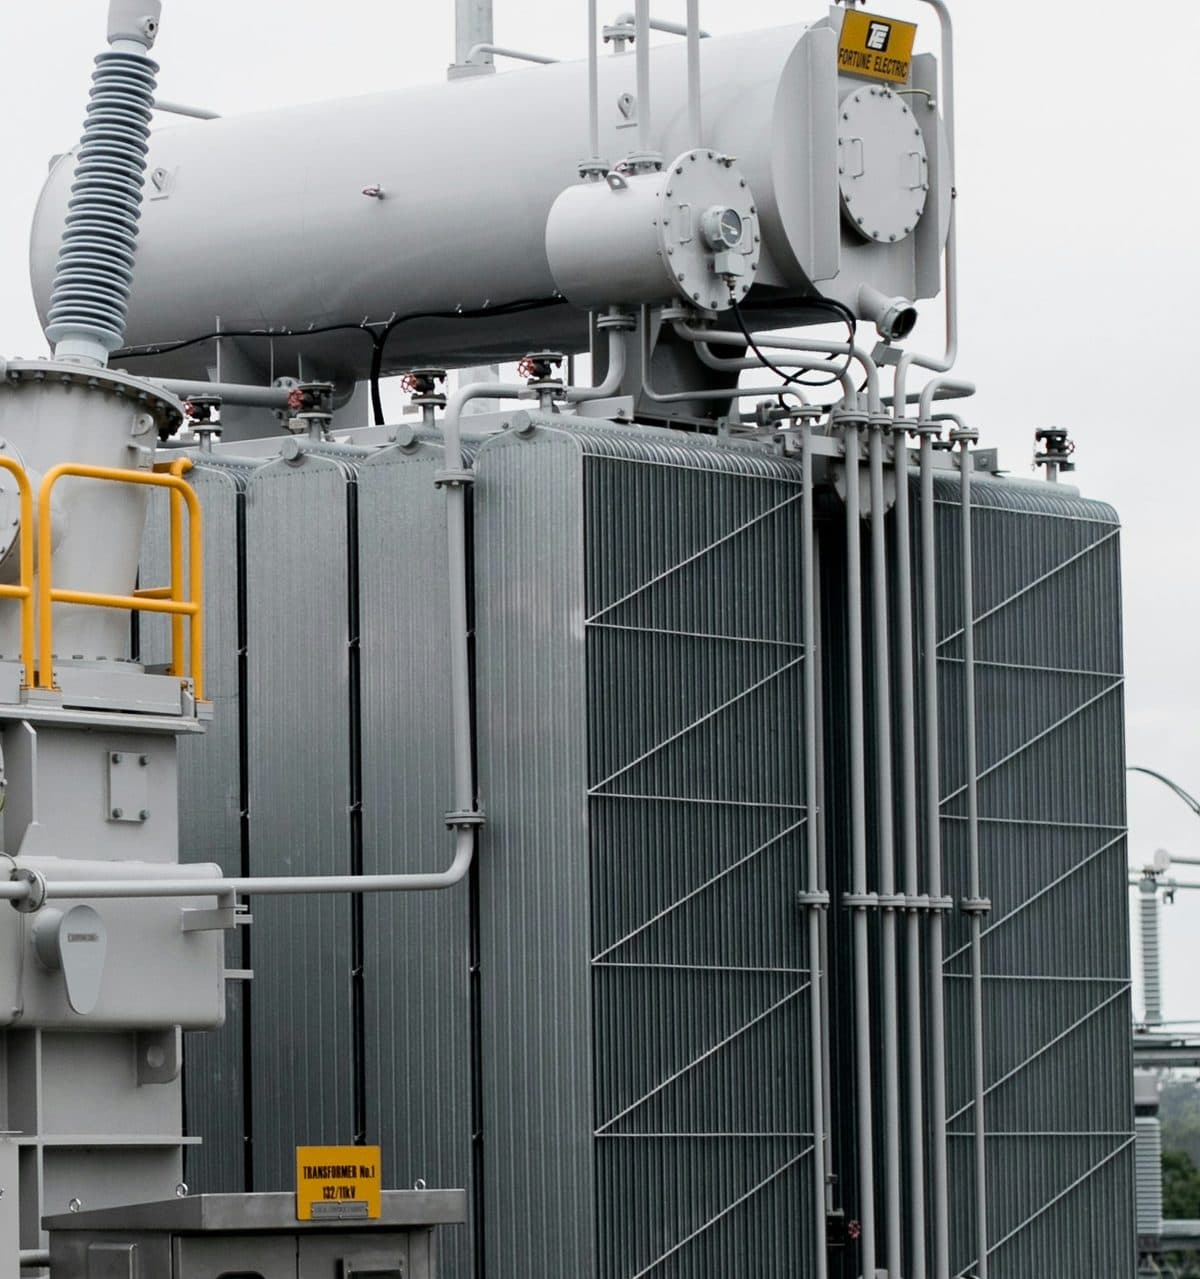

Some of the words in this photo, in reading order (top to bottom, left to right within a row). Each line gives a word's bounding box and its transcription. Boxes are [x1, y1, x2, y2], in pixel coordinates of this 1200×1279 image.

[838, 48, 872, 70] FORTUNE
[874, 56, 908, 78] ELECTRIC
[304, 1165, 356, 1179] TRANSFORMER
[360, 1165, 375, 1178] No.1
[323, 1186, 355, 1199] 132/11kV
